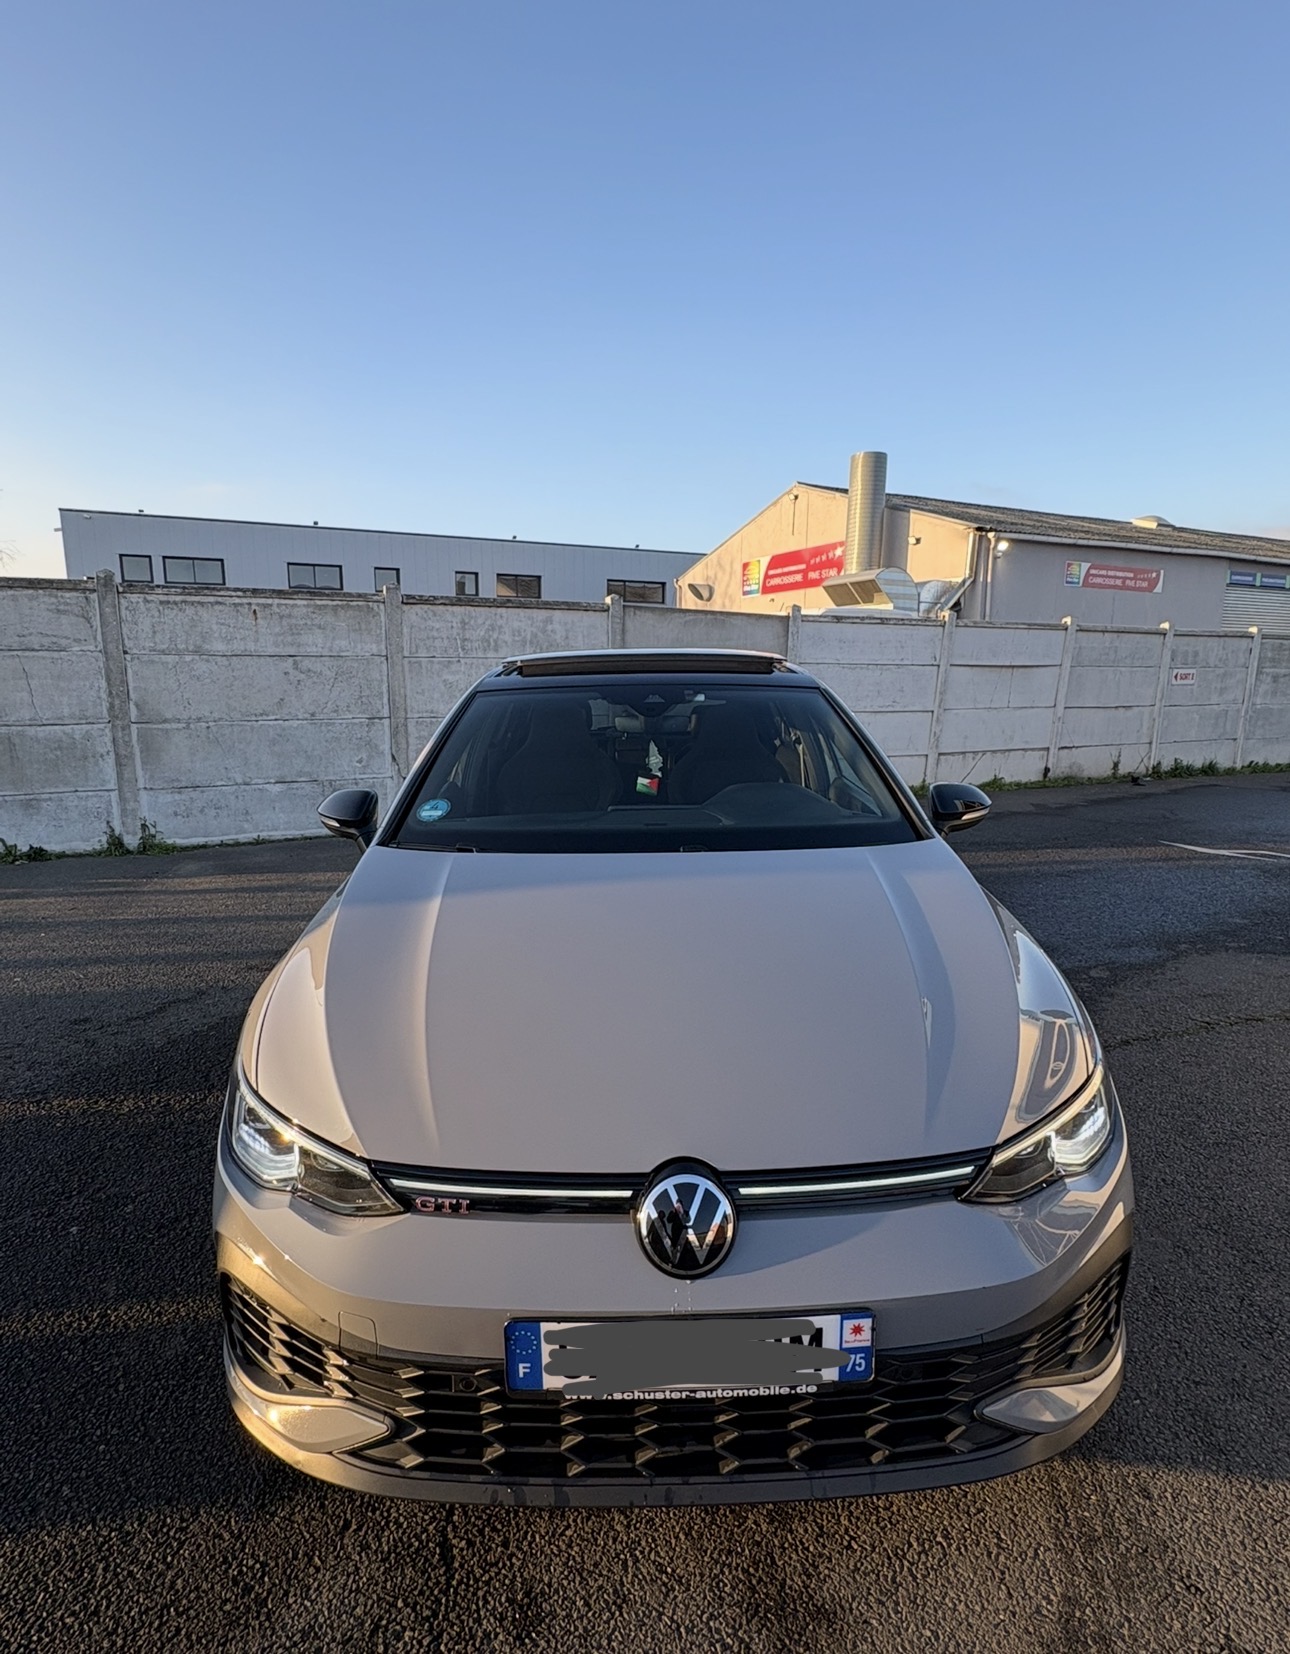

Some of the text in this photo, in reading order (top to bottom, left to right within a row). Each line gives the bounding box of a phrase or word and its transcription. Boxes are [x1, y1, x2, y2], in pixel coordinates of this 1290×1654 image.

[765, 572, 804, 587] CARROSSERIE
[821, 567, 839, 579] STAR
[1088, 576, 1123, 586] CARROSSERIE
[1136, 579, 1149, 588] STAR
[415, 1195, 470, 1215] GTI
[518, 1362, 531, 1379] F
[845, 1353, 866, 1373] 75
